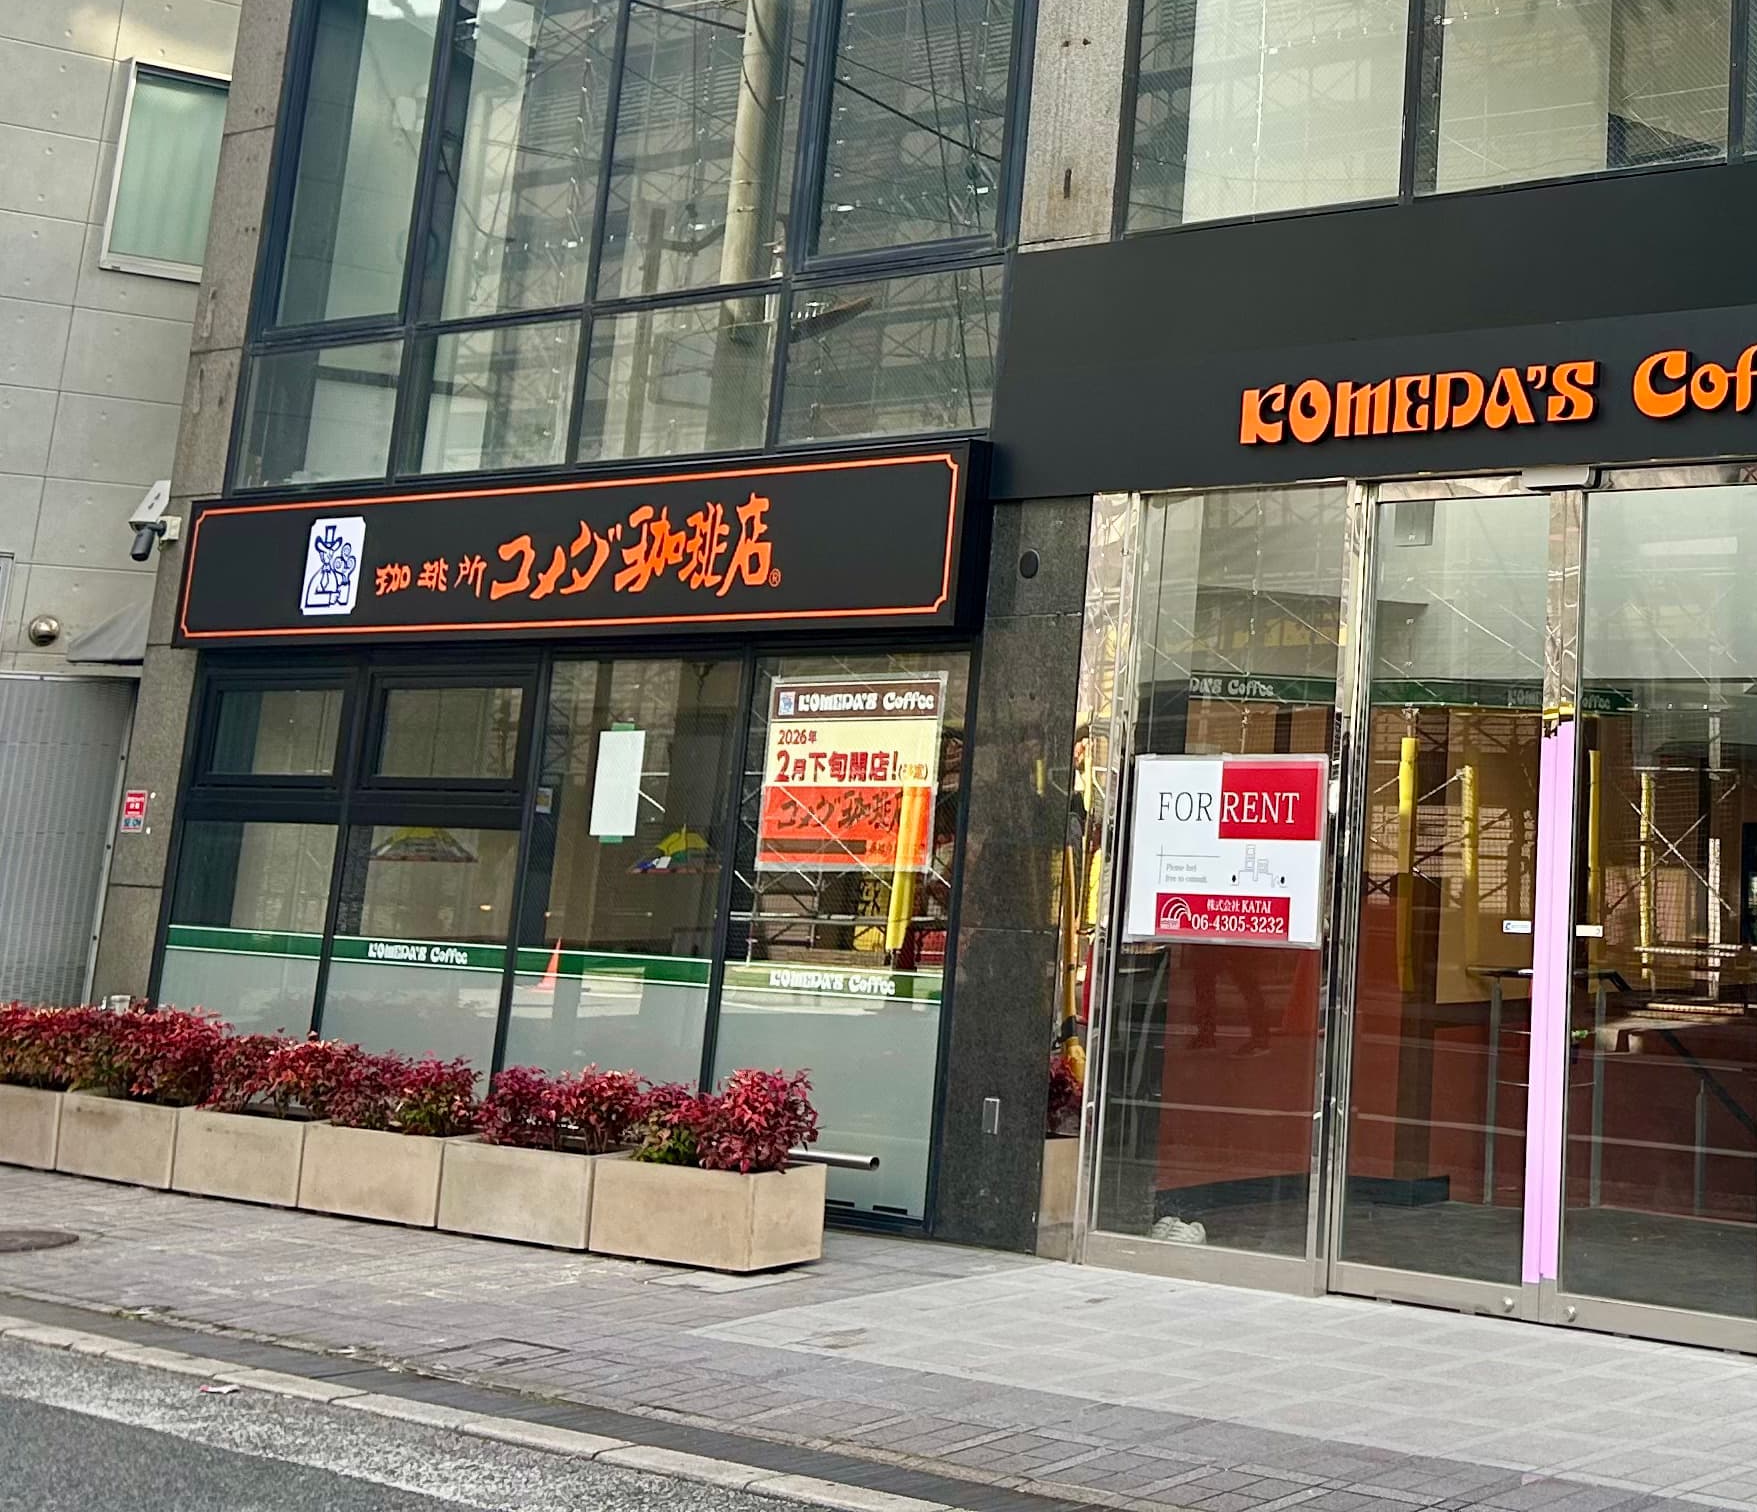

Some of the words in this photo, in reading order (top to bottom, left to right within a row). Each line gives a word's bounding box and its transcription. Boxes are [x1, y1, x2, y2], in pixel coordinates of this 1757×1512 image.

[1239, 360, 1598, 445] KOMEDA'S
[777, 729, 818, 745] 2026年
[1157, 791, 1213, 822] FOR
[1221, 791, 1300, 824] RENT
[1191, 914, 1284, 934] 06-4305-3232
